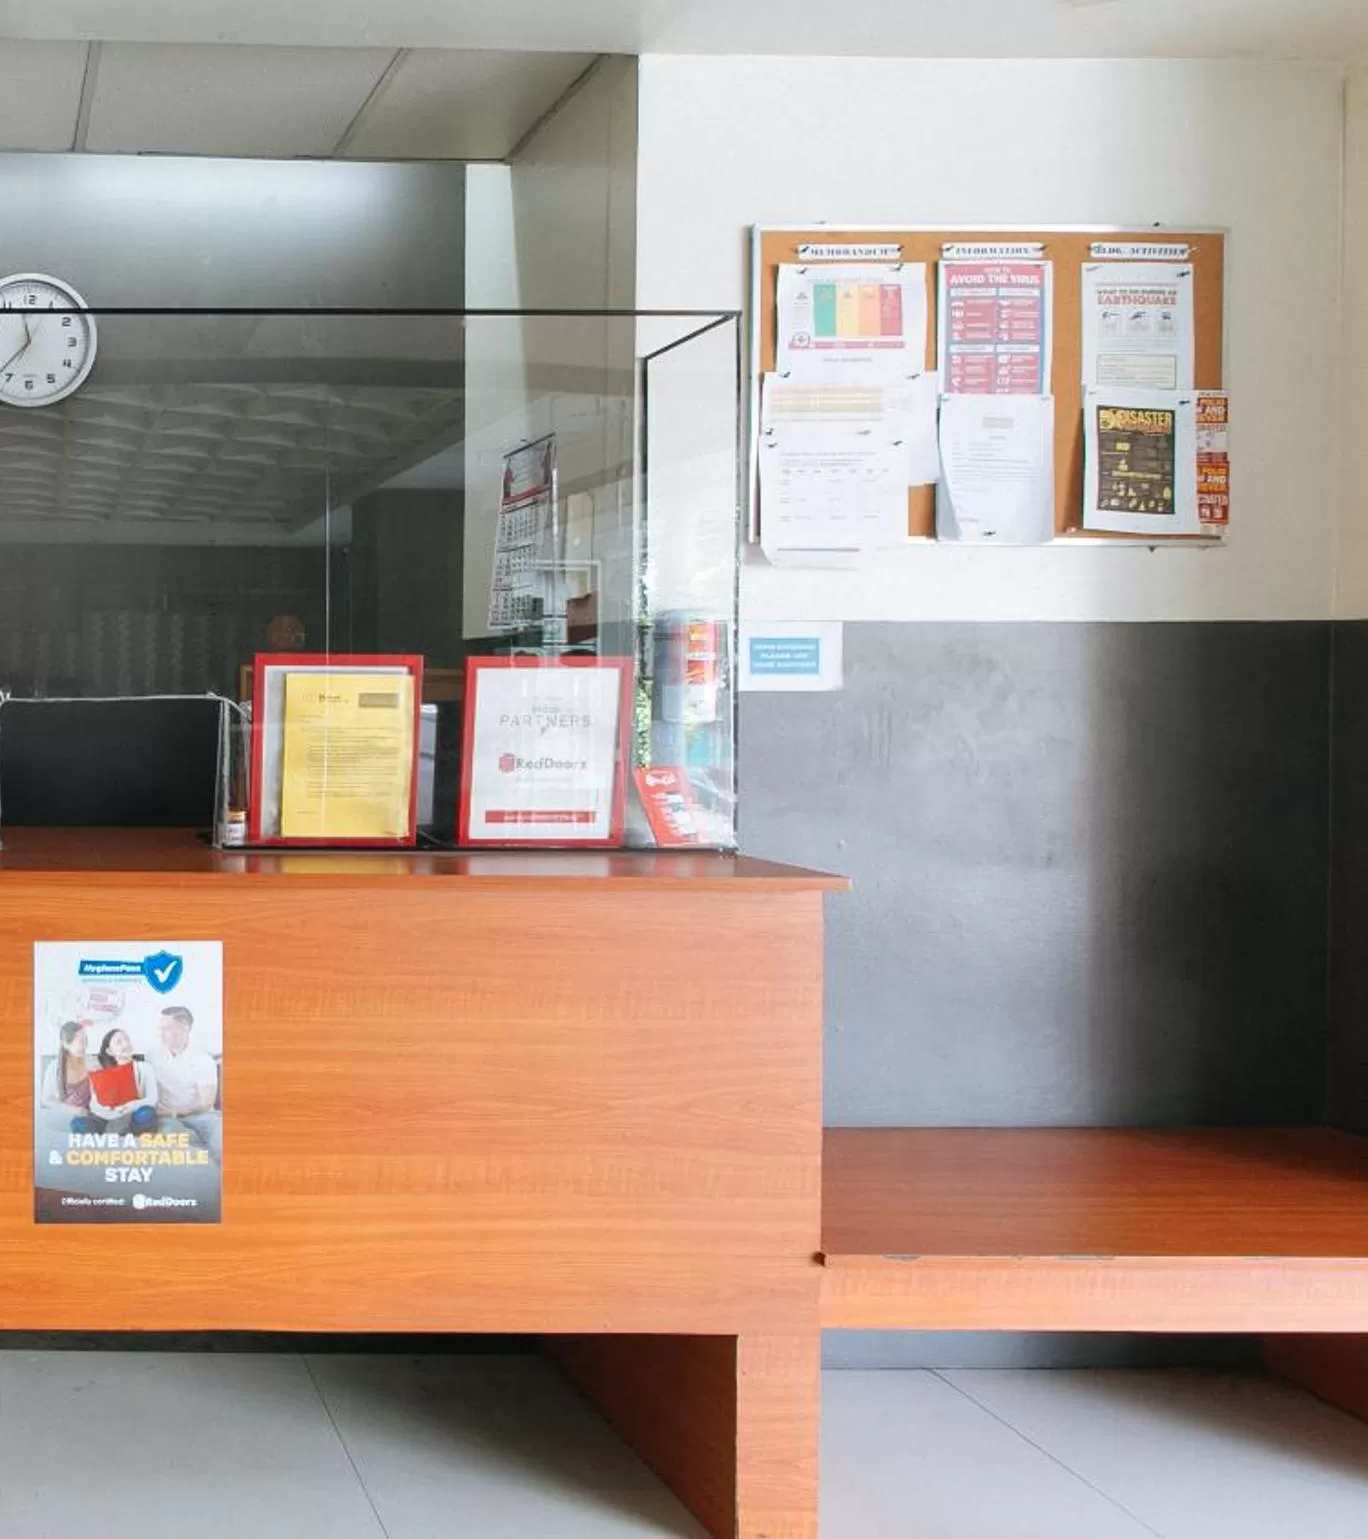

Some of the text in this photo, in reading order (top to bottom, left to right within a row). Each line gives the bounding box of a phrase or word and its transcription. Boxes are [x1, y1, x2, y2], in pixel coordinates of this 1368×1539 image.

[949, 275, 1040, 284] AVOID THE VIRUS
[23, 295, 37, 305] 12
[1097, 295, 1177, 305] EARTHQUAKE
[61, 316, 72, 327] 2
[67, 337, 78, 347] 3
[62, 358, 72, 368] 4
[4, 373, 15, 383] 7
[46, 373, 56, 384] 5
[24, 380, 35, 390] 6
[499, 714, 591, 729] PARTNERS
[68, 1133, 189, 1148] HAVE A SAFE
[49, 1150, 209, 1165] & COMFORTABLE
[105, 1167, 154, 1182] STAY
